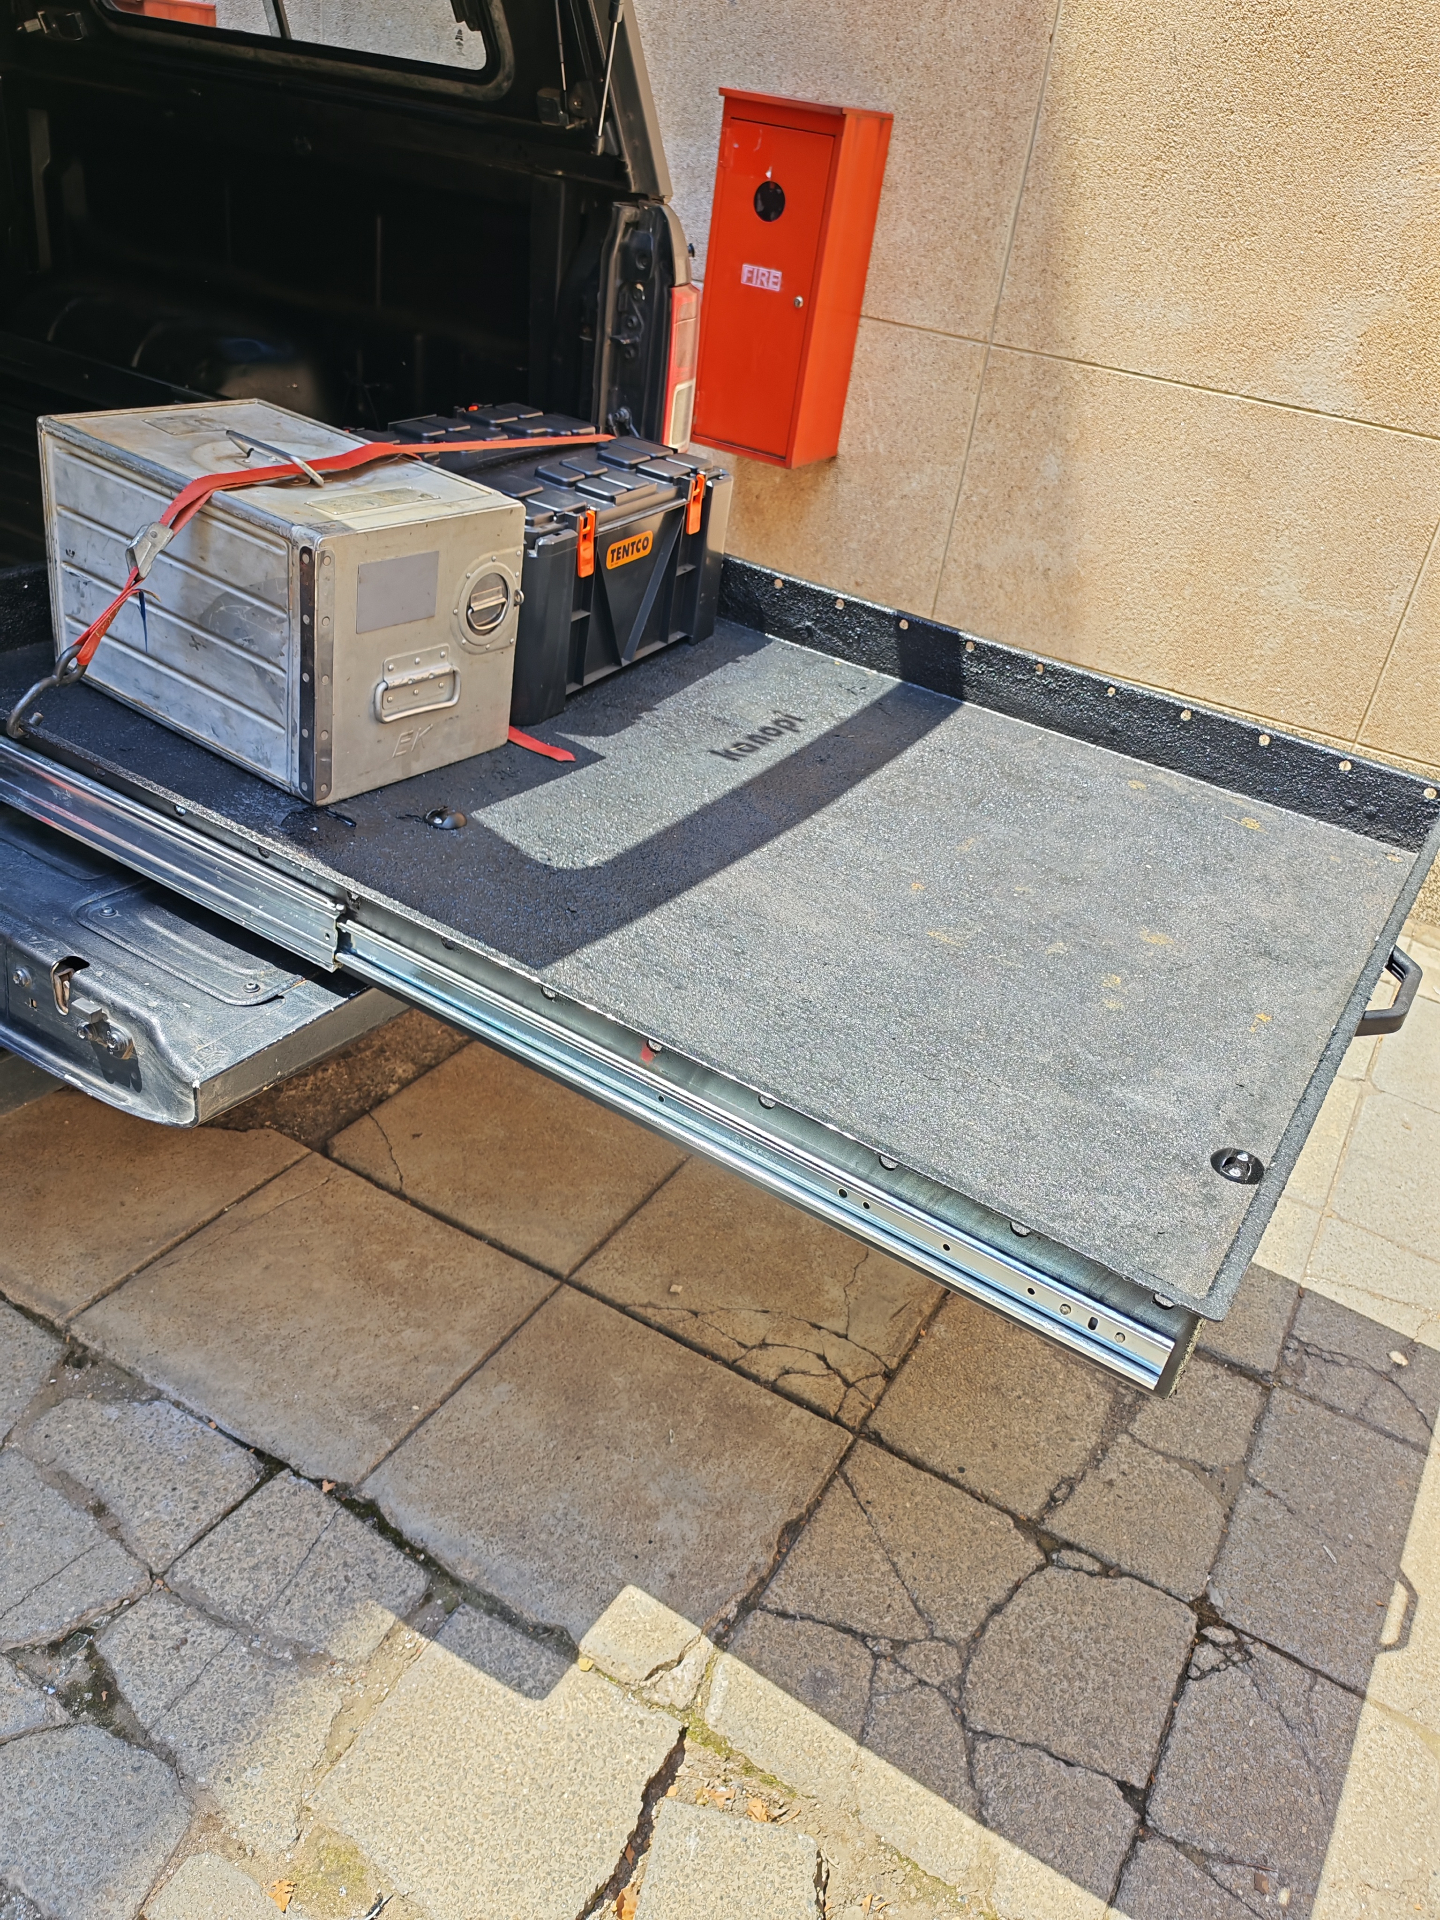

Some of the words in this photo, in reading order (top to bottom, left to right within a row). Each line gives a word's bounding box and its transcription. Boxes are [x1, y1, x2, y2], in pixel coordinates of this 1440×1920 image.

[741, 264, 781, 291] FIRE
[610, 536, 650, 563] TENTCO
[392, 723, 433, 758] EK
[707, 709, 805, 762] kanopi
